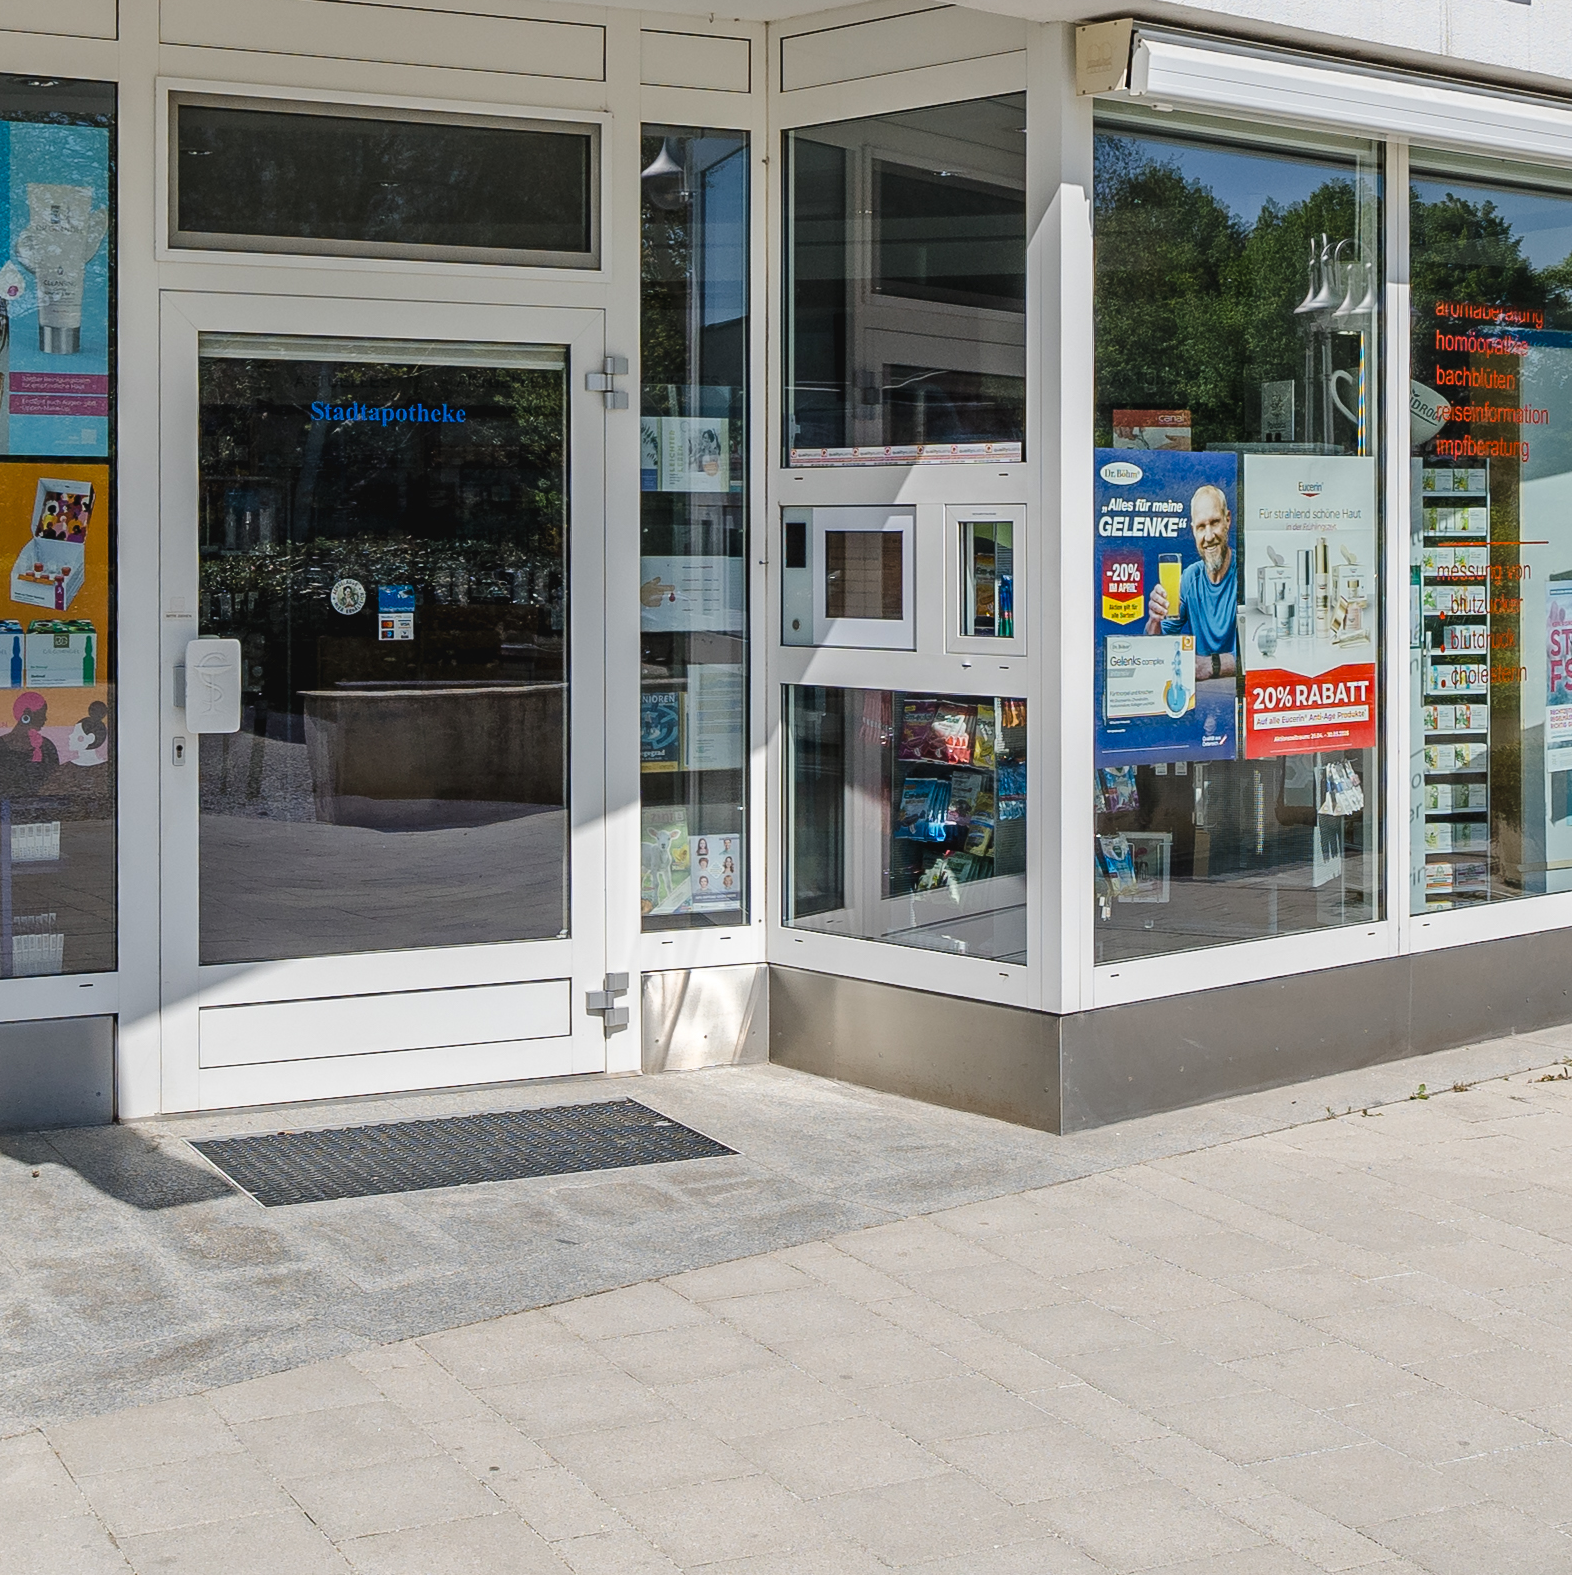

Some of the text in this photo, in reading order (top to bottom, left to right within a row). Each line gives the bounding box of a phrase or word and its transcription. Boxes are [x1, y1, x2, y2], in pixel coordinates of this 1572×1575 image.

[1435, 300, 1544, 329] aromaberatung
[1435, 329, 1529, 358] homöopathie
[1436, 364, 1516, 390] bachblüten
[310, 400, 467, 426] Stadtapotheke
[1436, 401, 1549, 424] reiseinformation
[1436, 435, 1530, 463] impfberatung
[1104, 468, 1116, 478] Dr.
[1135, 499, 1152, 512] für
[1152, 500, 1184, 513] meine
[1259, 508, 1362, 519] Für strahlend schöne Haut
[1106, 563, 1141, 581] -20%
[1437, 564, 1531, 586] messung von
[1451, 594, 1523, 614] blutzucker
[1451, 628, 1516, 649] blutdruck
[1110, 655, 1141, 666] Gelenks
[1451, 665, 1528, 686] cholesterin
[642, 694, 676, 704] NIOREN
[1252, 680, 1369, 710] 20% RABATT
